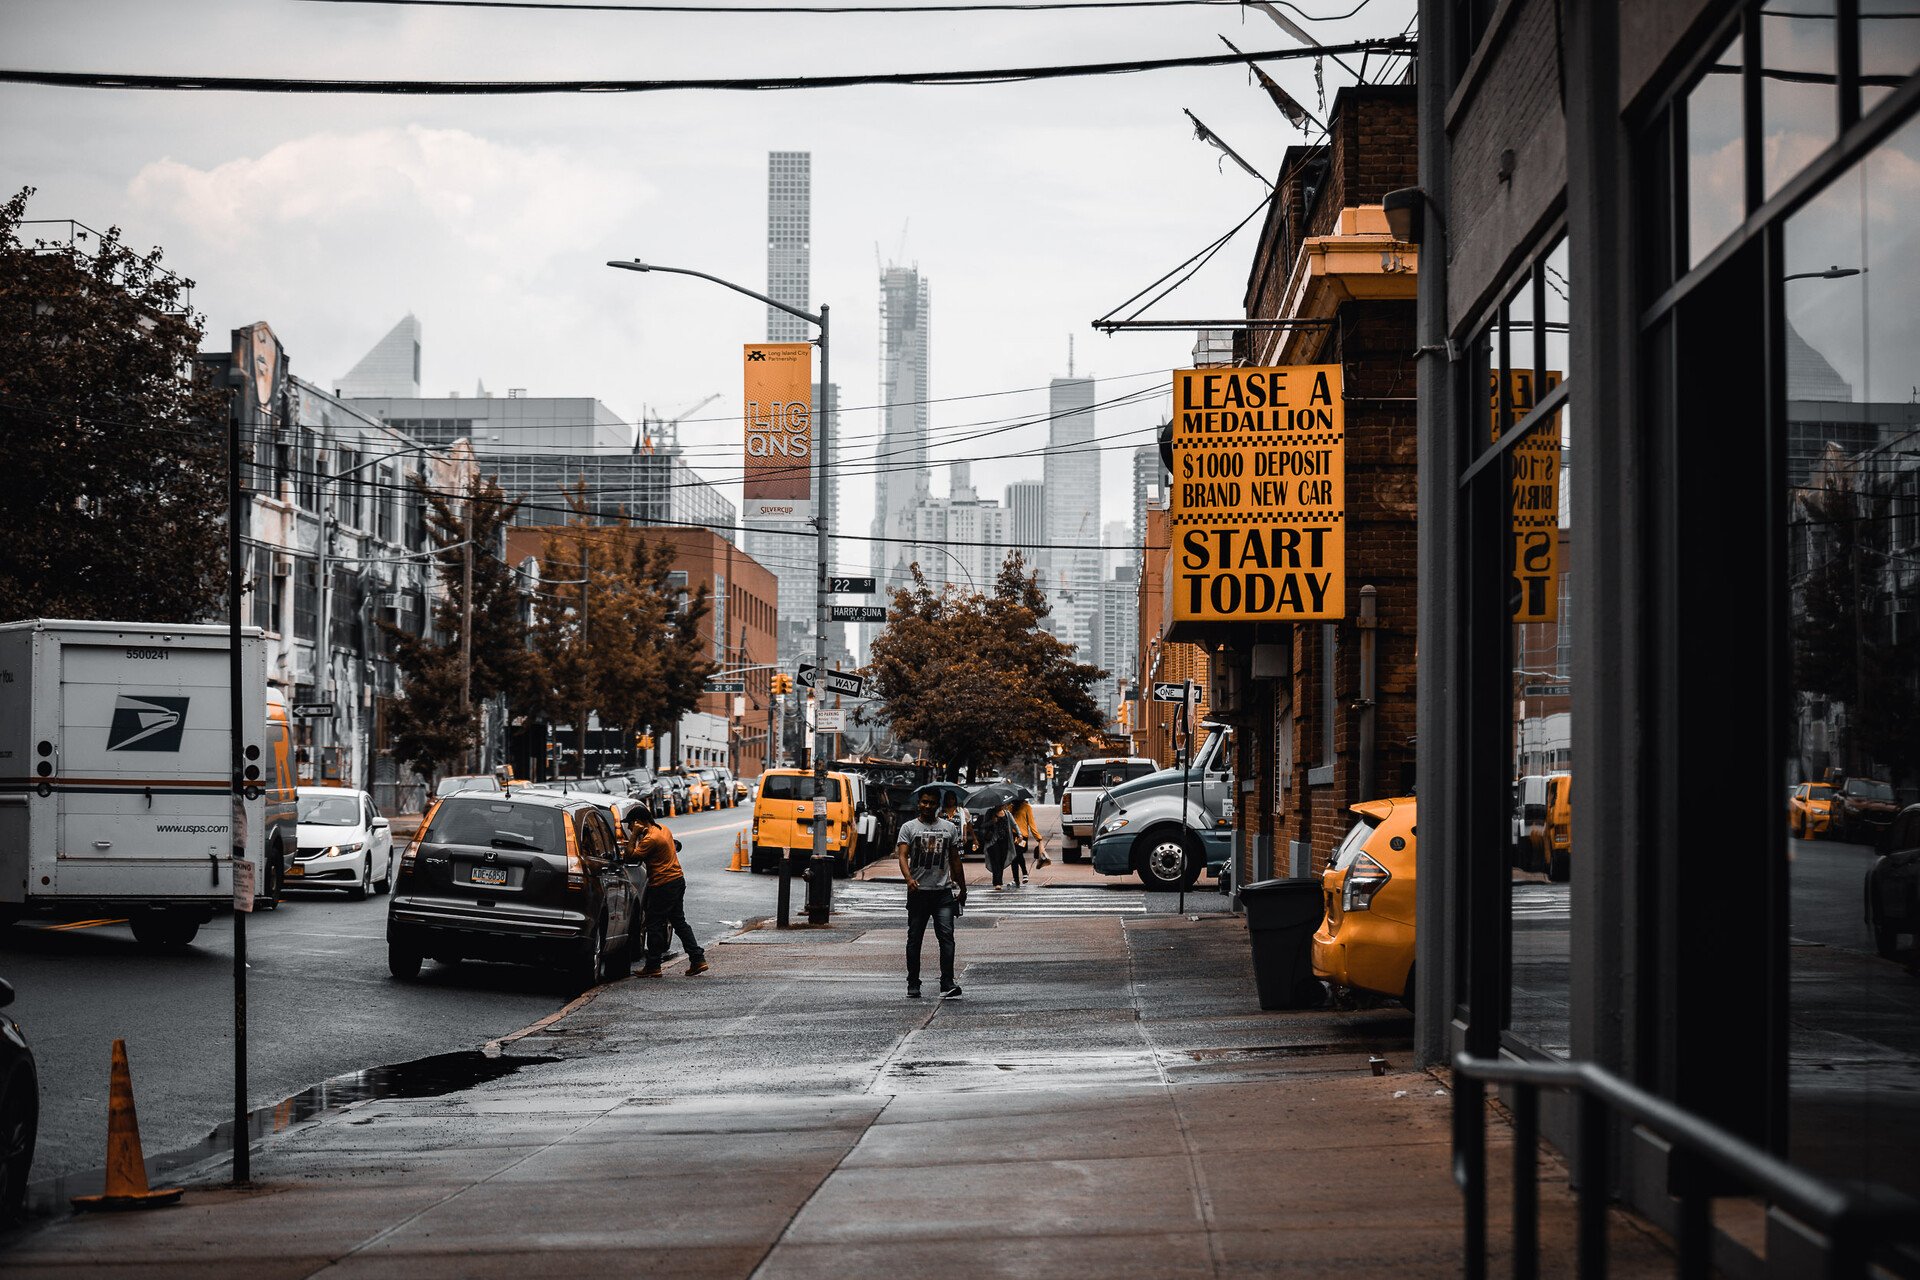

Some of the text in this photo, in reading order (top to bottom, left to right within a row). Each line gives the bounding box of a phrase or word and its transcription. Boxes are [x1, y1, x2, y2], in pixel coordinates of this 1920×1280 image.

[1183, 371, 1332, 410] LEASE A
[747, 401, 809, 434] LIC
[1183, 408, 1333, 434] MEDALLION
[747, 435, 809, 458] QNS
[1183, 450, 1333, 481] $1000 DEPOSIT
[1183, 480, 1333, 508] BRAND NEW CAR
[760, 506, 794, 515] SILVERCUP
[1183, 528, 1333, 571] START
[834, 579, 850, 592] 22
[1183, 572, 1332, 614] TODAY
[833, 607, 882, 617] HARRY SUNA
[126, 650, 169, 660] 5500241
[835, 677, 856, 691] WAY
[1160, 688, 1175, 697] ONE
[156, 825, 229, 835] www.usps.com
